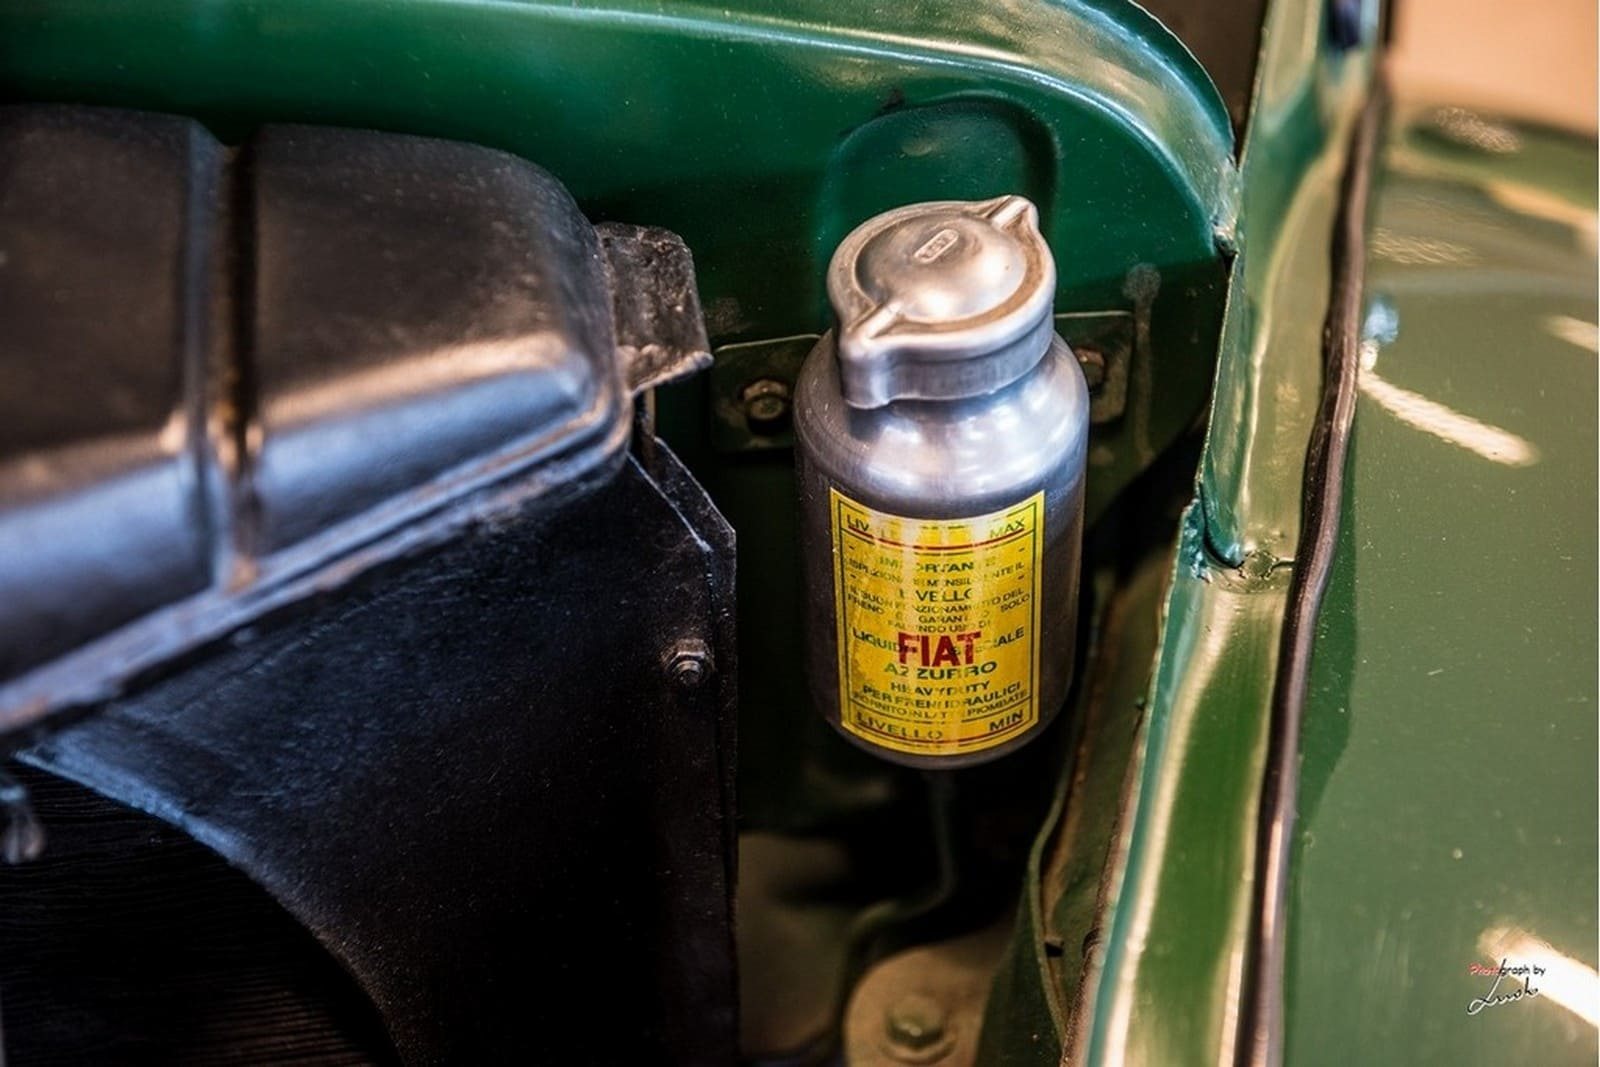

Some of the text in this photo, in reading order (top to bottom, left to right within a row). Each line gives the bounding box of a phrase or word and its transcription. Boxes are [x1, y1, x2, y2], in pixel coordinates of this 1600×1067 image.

[990, 517, 1025, 538] MAX
[1000, 593, 1031, 613] SOLO
[898, 630, 982, 668] FIAT
[884, 660, 998, 681] AZZURRO
[989, 709, 1024, 731] MIN
